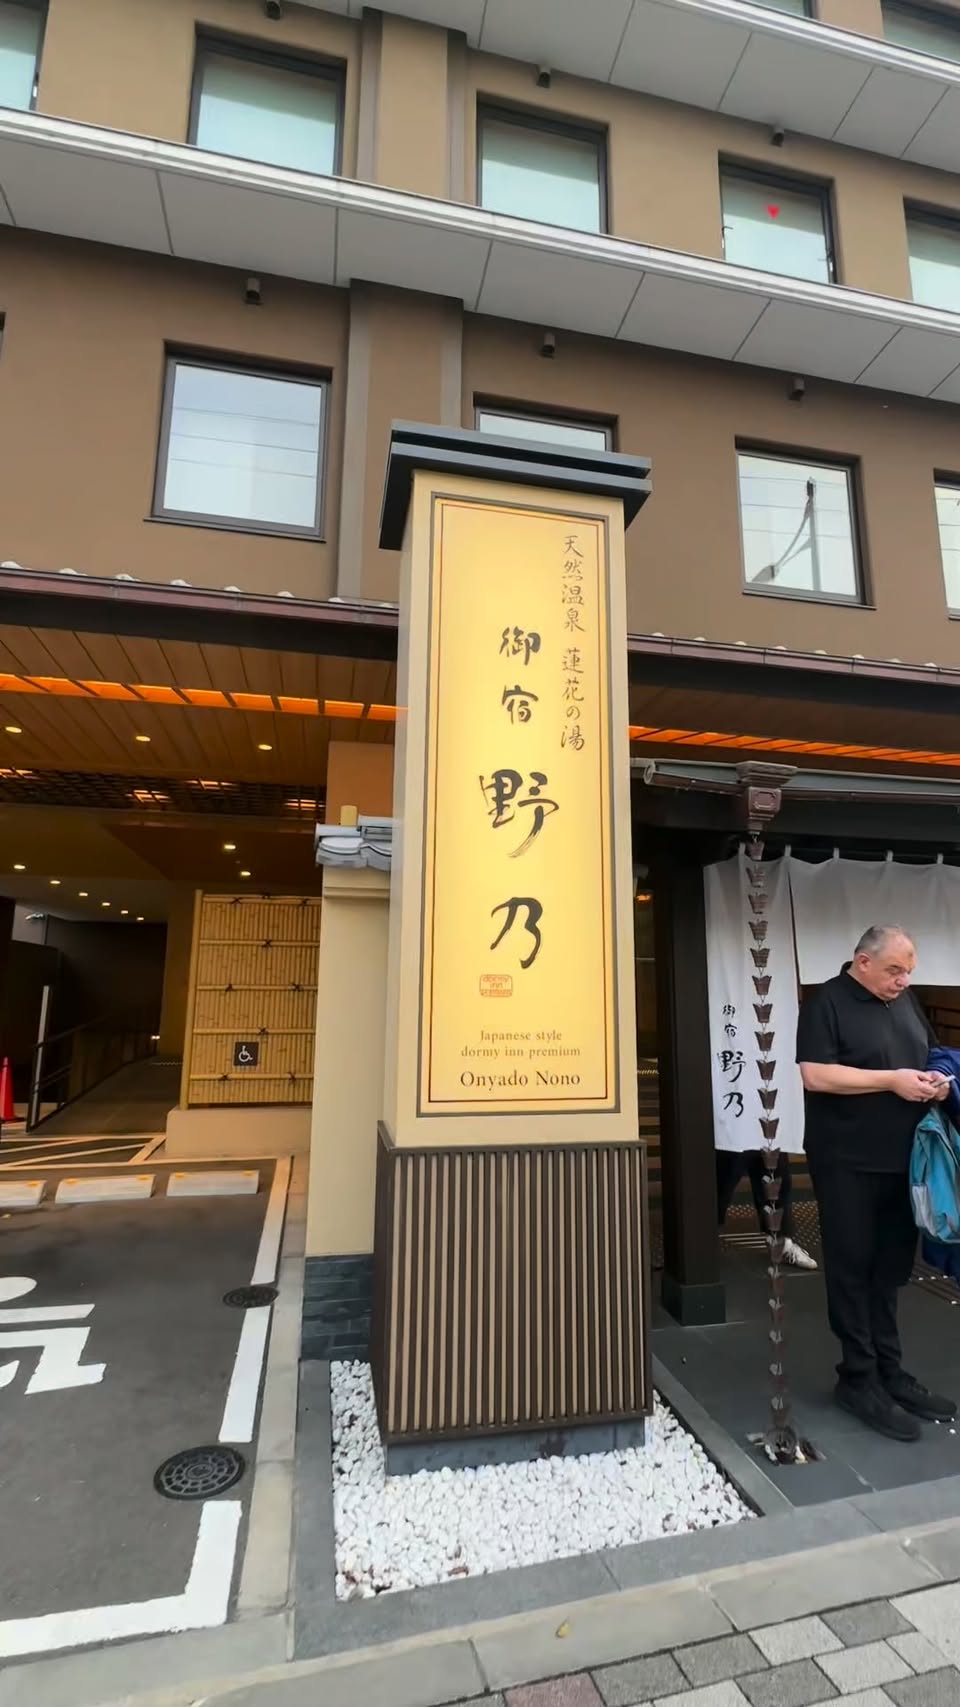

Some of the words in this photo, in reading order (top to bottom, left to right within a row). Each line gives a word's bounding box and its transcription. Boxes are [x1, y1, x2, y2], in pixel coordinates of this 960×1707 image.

[561, 535, 585, 633] 天然温泉
[560, 647, 585, 751] 蓮花の湯
[480, 1030, 532, 1043] Japanese
[536, 1030, 562, 1043] style
[461, 1045, 500, 1060] dormy
[505, 1046, 524, 1057] inn
[529, 1046, 581, 1060] premium
[460, 1069, 529, 1092] Onyado
[535, 1070, 581, 1086] Nono
